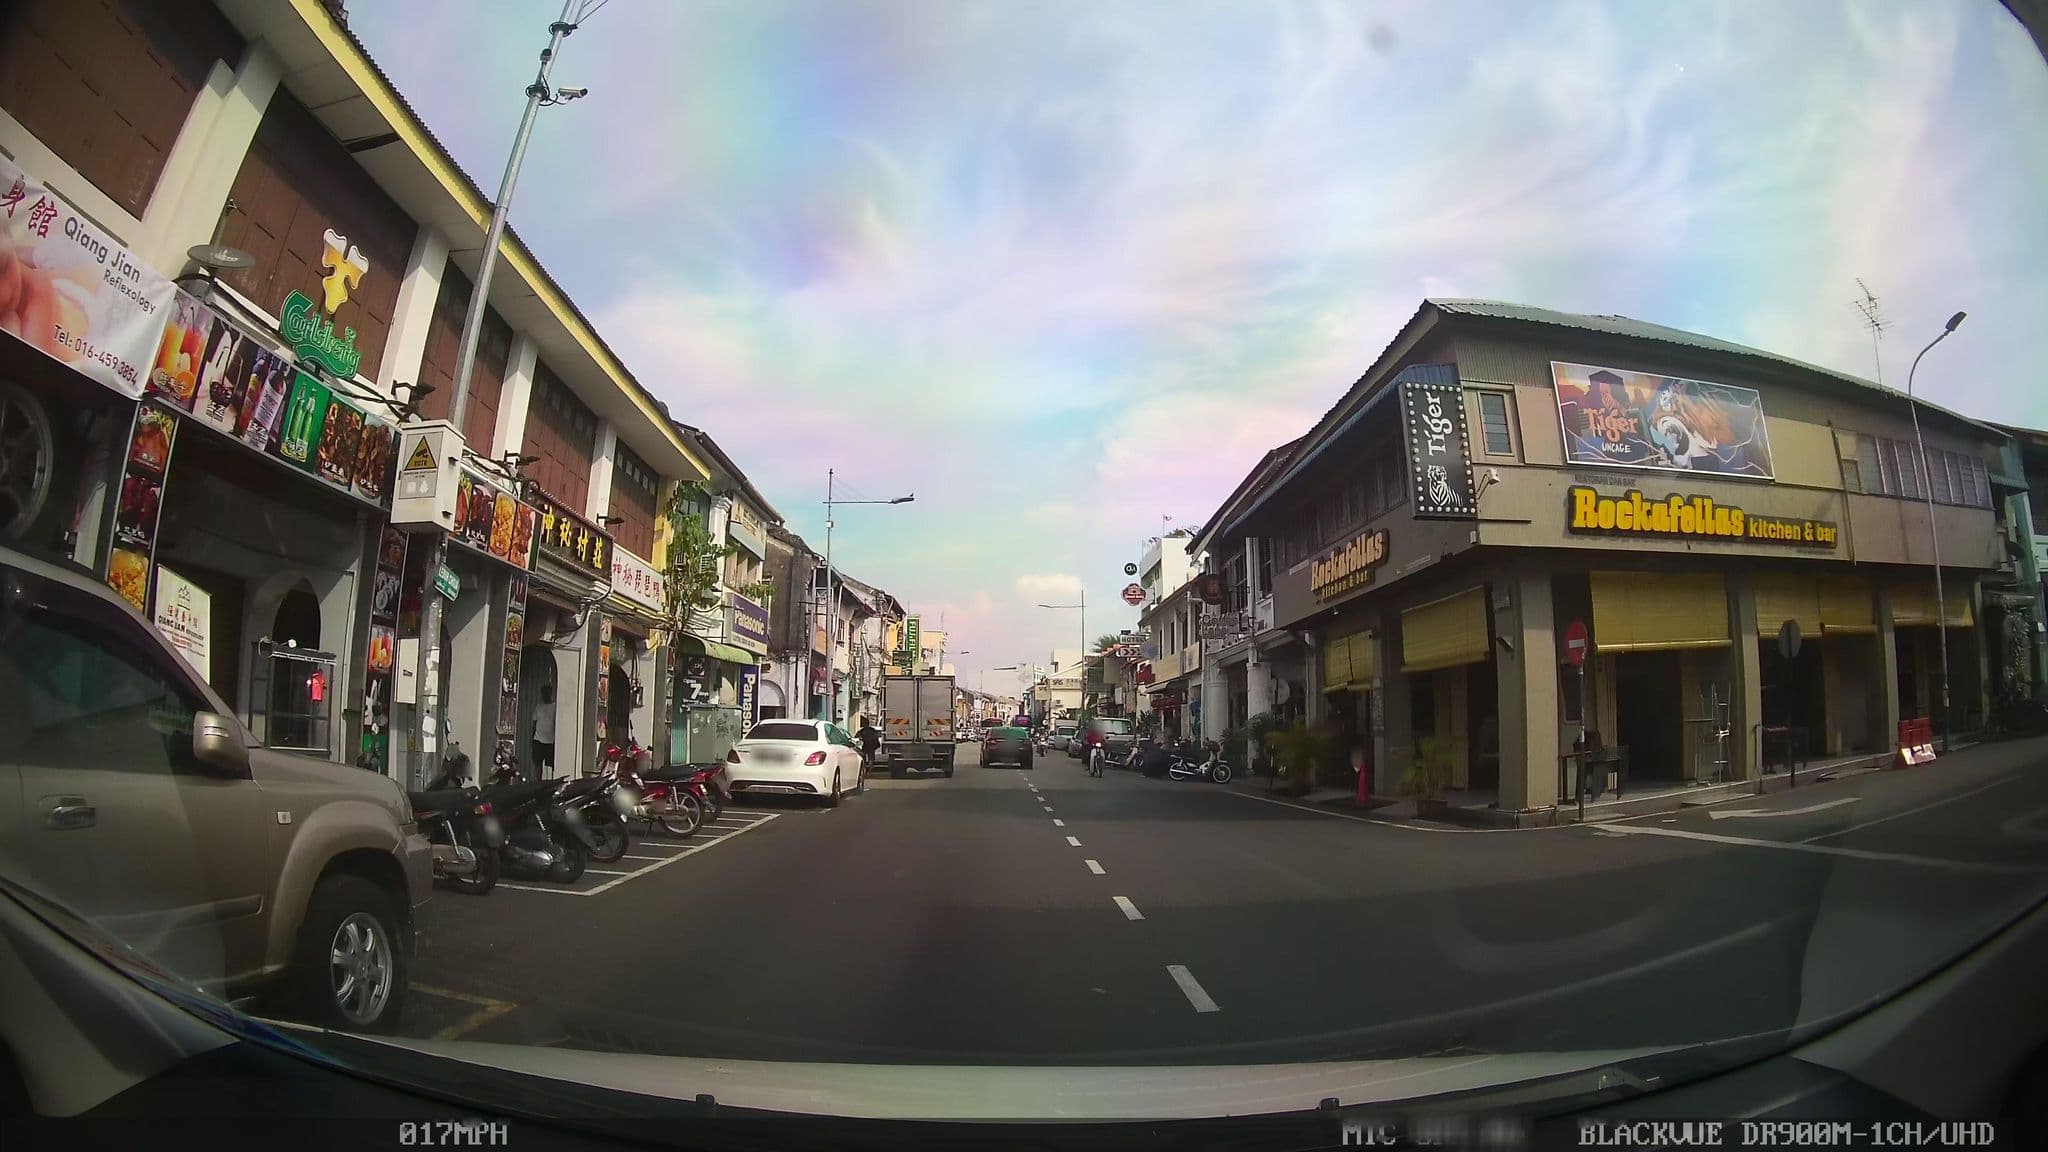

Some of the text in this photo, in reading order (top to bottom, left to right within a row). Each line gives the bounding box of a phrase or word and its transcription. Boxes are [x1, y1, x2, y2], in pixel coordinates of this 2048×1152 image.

[64, 216, 141, 283] Qiang Jian
[103, 268, 157, 315] Reflexology
[54, 324, 73, 348] Tel:
[1421, 391, 1453, 457] Tiger
[1583, 407, 1638, 443] Tiger
[1601, 442, 1632, 453] UNCAGE
[1804, 521, 1814, 541] &
[1816, 523, 1837, 543] bar
[690, 683, 702, 700] 7
